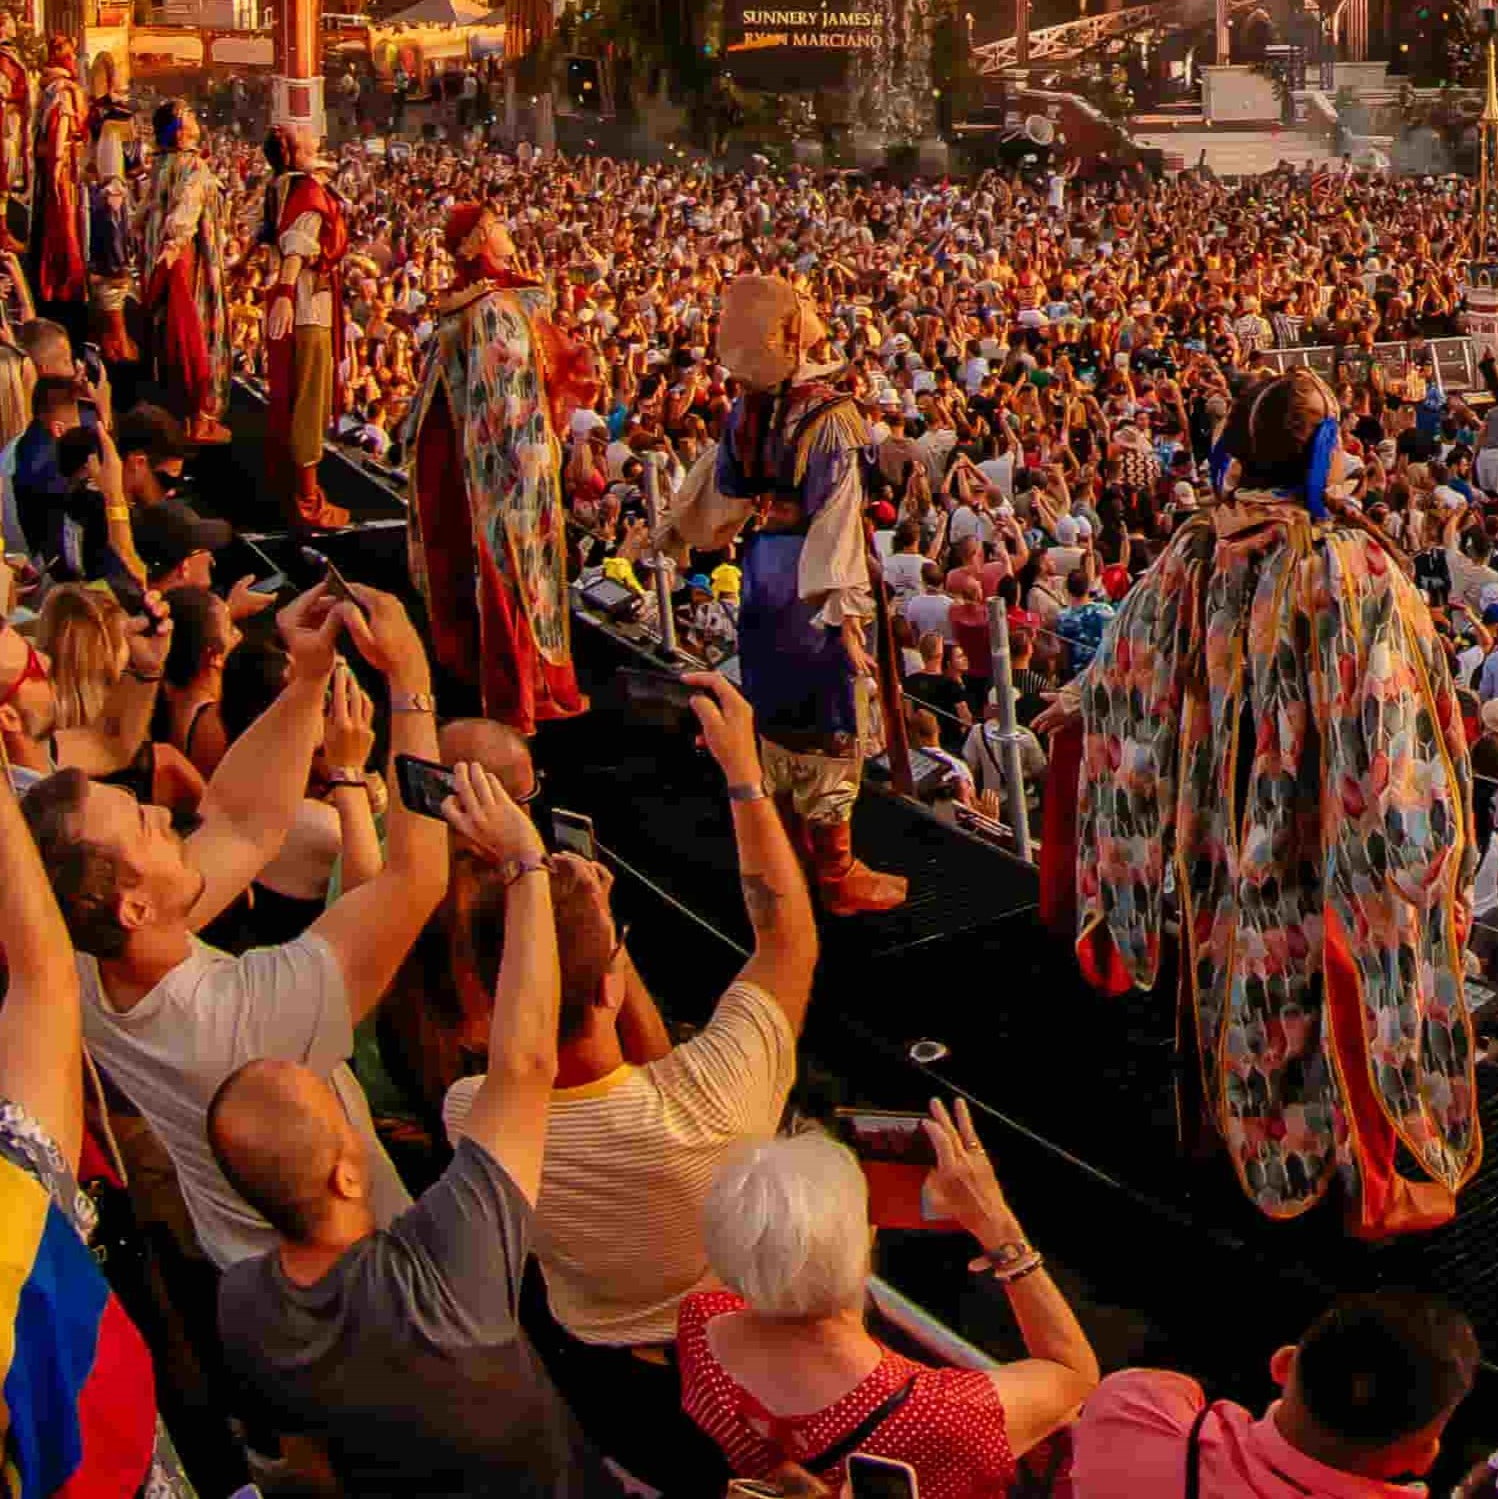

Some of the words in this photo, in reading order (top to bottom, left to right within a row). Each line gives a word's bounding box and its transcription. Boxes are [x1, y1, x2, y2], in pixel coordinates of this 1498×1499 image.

[743, 10, 818, 26] SUNNERY
[823, 11, 871, 28] JAMES
[793, 33, 882, 47] MARCIANO
